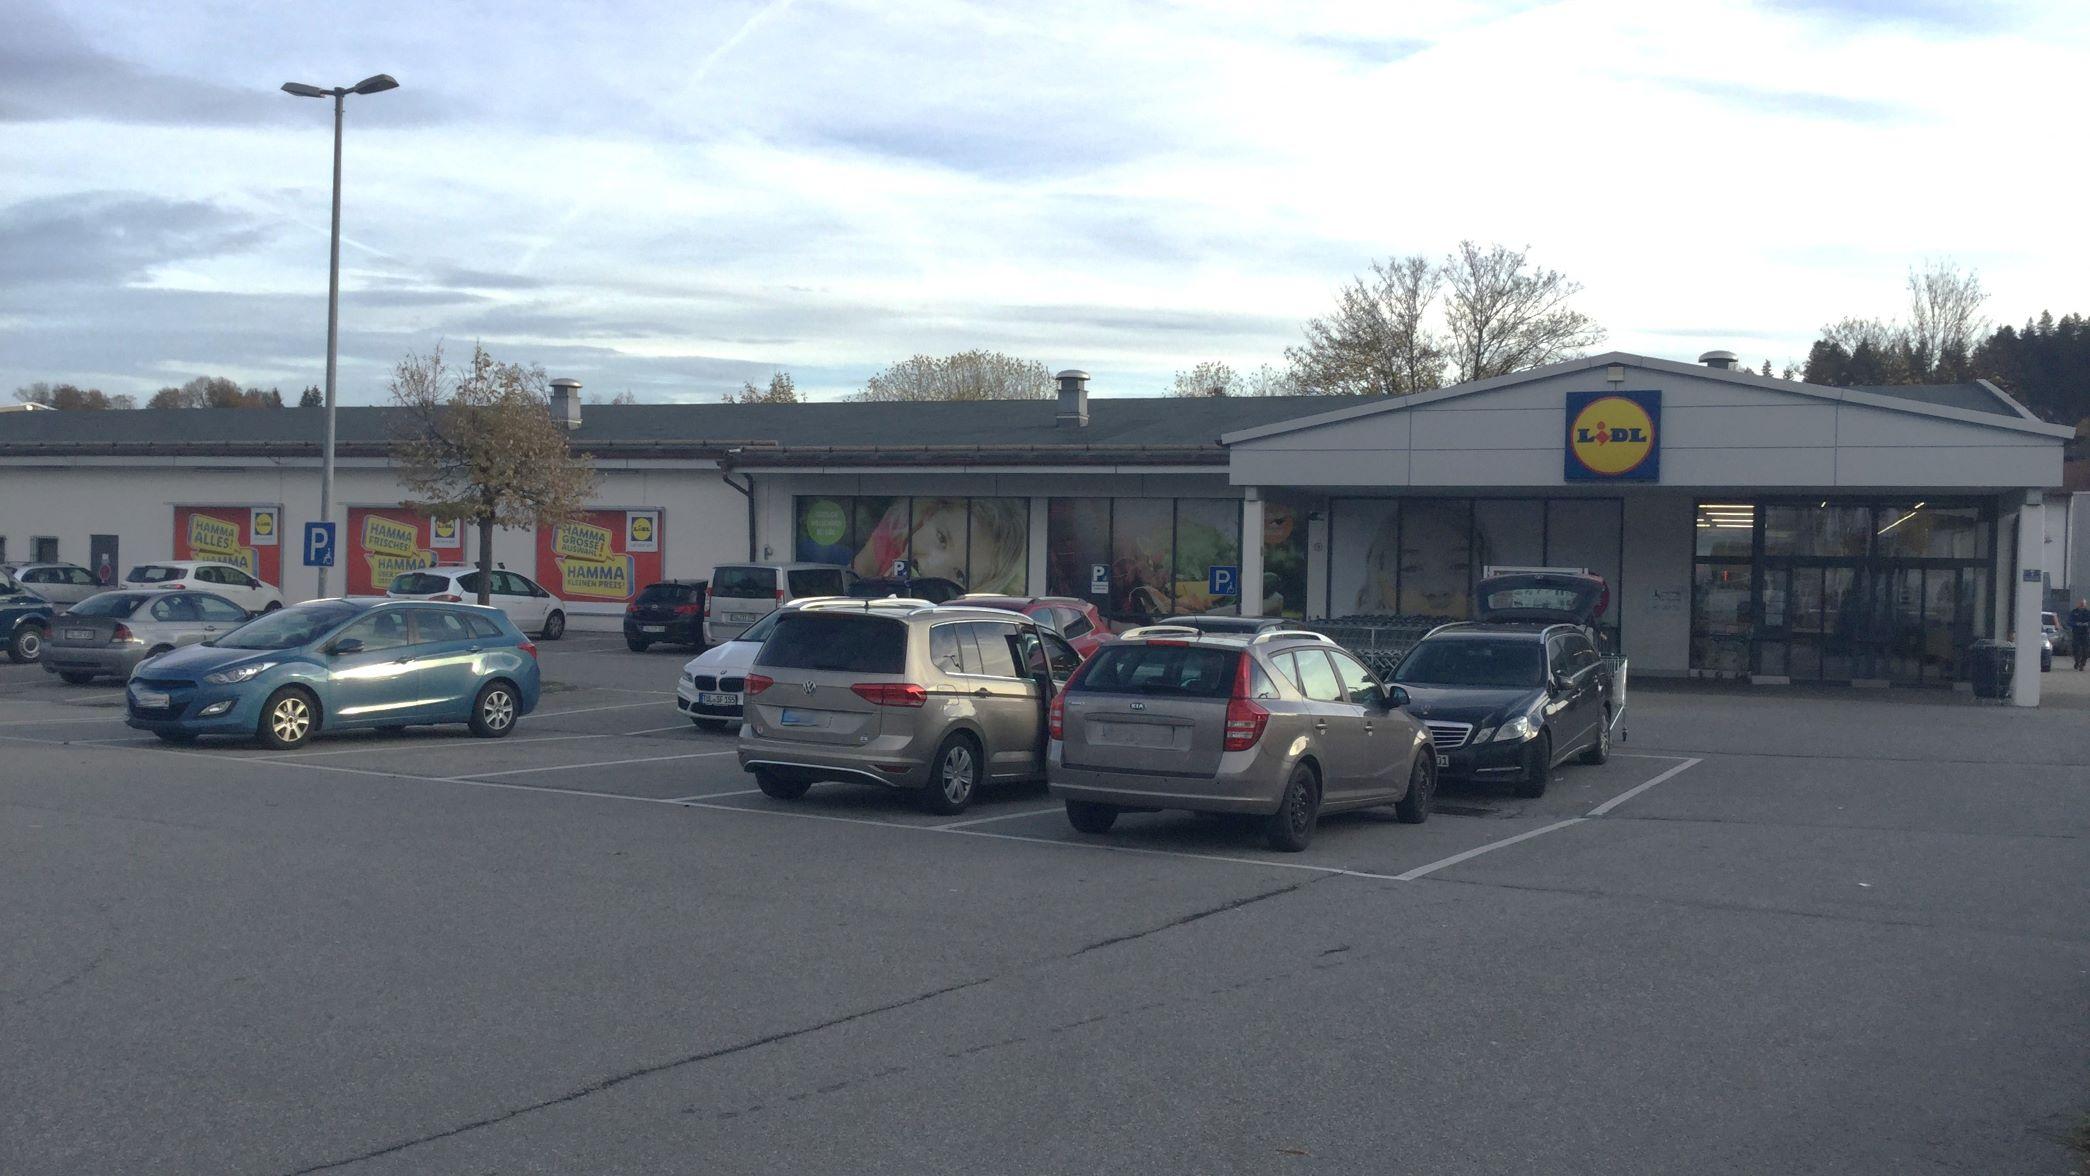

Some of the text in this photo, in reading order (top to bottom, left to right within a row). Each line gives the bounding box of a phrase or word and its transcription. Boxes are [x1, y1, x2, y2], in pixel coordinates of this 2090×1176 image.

[195, 518, 234, 537] HAMMA
[370, 523, 412, 541] HAMMA
[563, 525, 605, 543] HAMMA
[195, 532, 234, 549] ALLES!
[311, 527, 328, 560] P
[562, 535, 599, 550] GROSSE
[378, 558, 426, 571] HAMMA
[894, 562, 905, 576] P
[567, 566, 624, 581] HAMMA
[1215, 570, 1230, 591] P
[568, 579, 597, 587] KLEINEN
